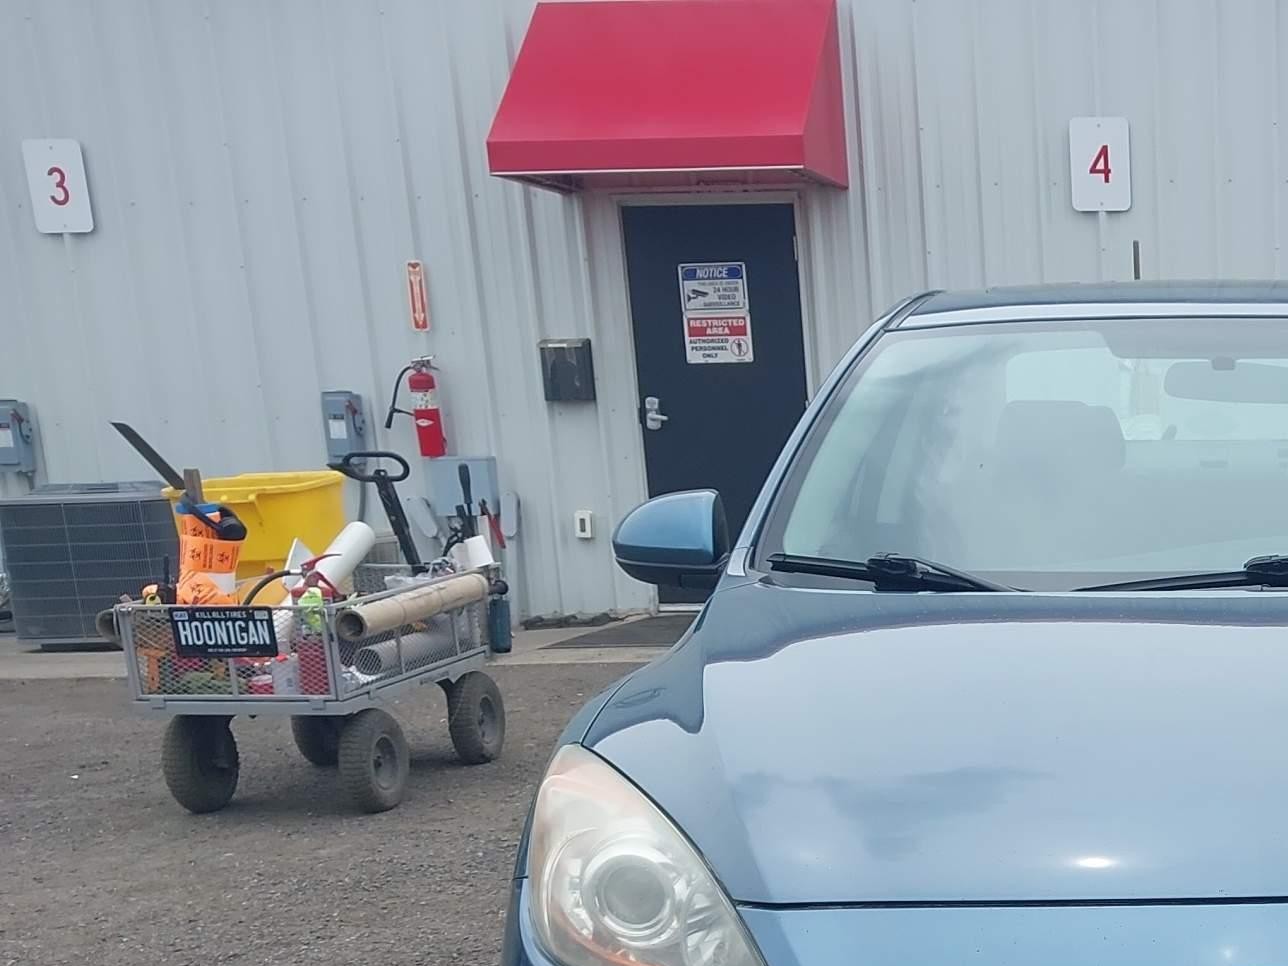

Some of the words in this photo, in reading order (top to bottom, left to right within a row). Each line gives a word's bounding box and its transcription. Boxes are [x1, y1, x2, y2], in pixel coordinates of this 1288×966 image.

[1089, 144, 1111, 184] 4
[47, 166, 69, 206] 3
[695, 267, 729, 279] NOTICE
[689, 319, 745, 328] RESTRICTED
[706, 327, 730, 335] AREA
[177, 620, 271, 646] HOON1GAN
